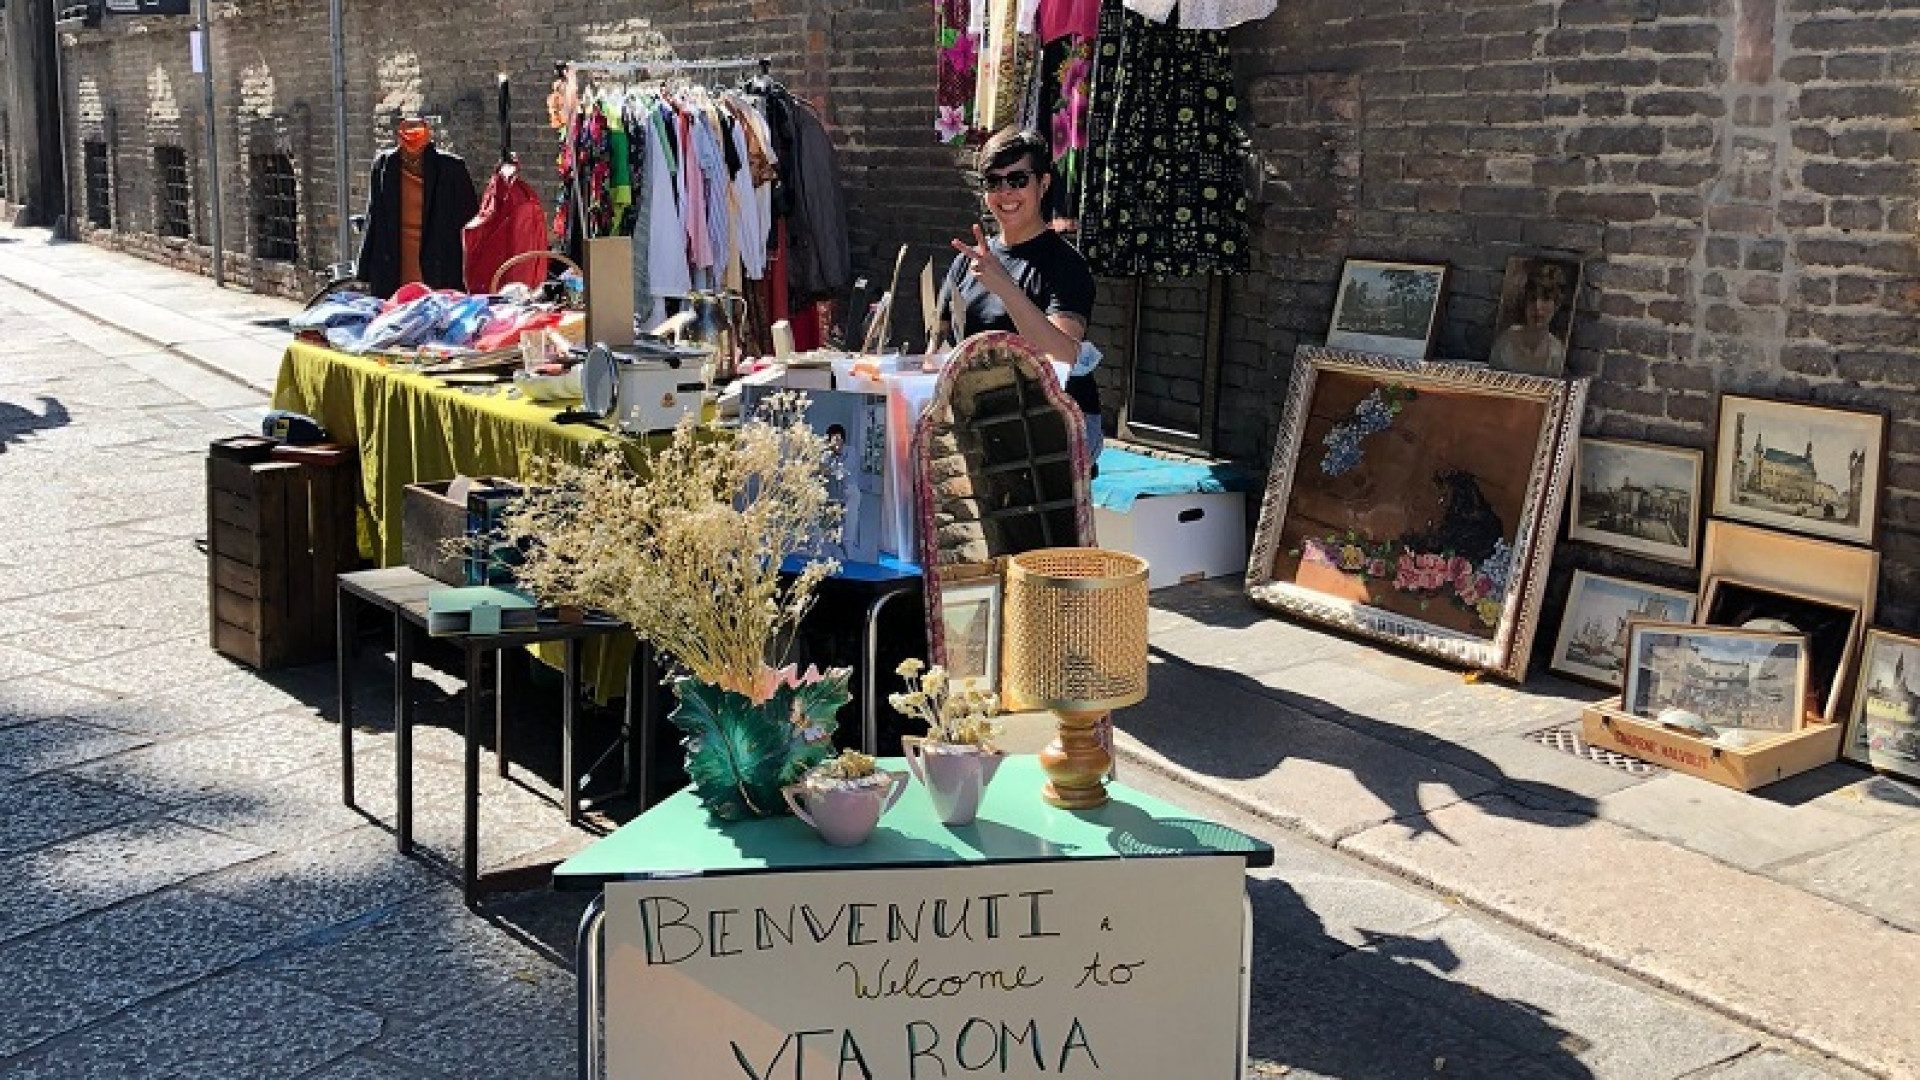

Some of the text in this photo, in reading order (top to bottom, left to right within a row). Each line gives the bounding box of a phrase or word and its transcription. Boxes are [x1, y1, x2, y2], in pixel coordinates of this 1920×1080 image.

[640, 889, 1060, 965] BENVENUTI
[835, 952, 1147, 1000] Welcome to
[729, 1016, 1100, 1080] VIA ROMA
